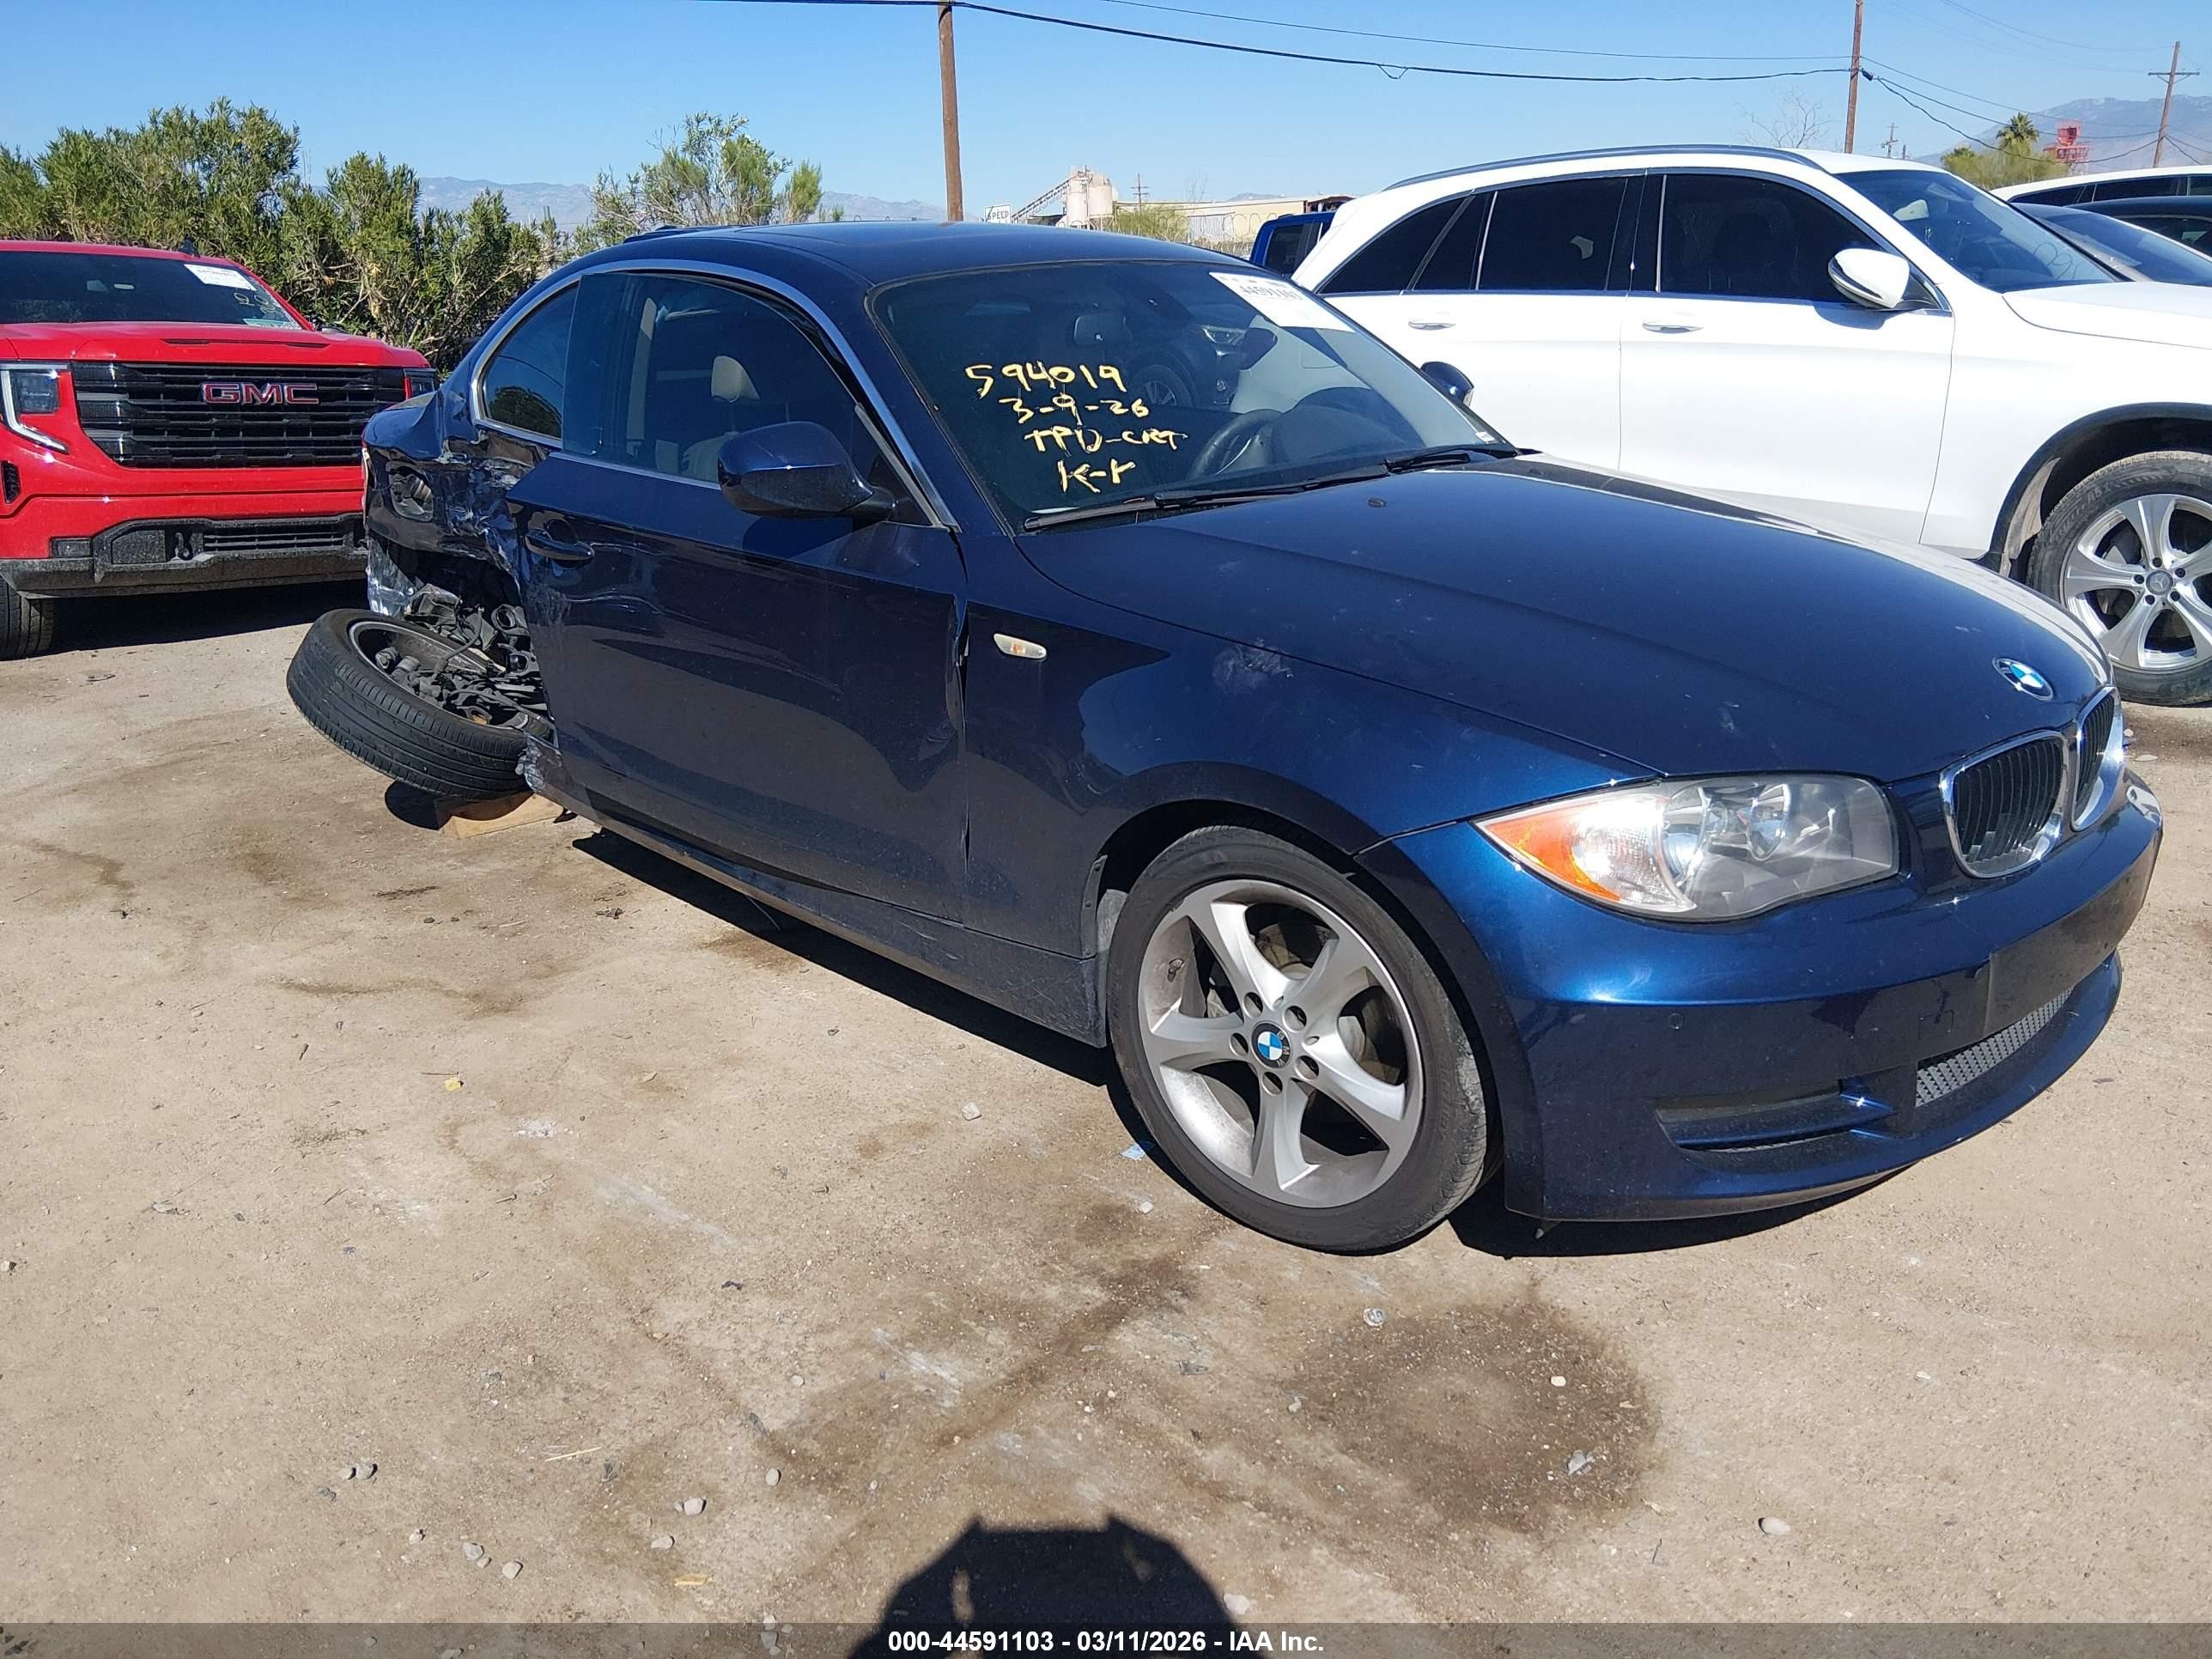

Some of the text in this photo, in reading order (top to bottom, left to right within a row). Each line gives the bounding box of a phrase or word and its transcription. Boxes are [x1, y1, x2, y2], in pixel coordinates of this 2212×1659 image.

[202, 383, 319, 404] GMC
[964, 361, 1127, 398] 594019
[998, 392, 1149, 426] 3-9-26
